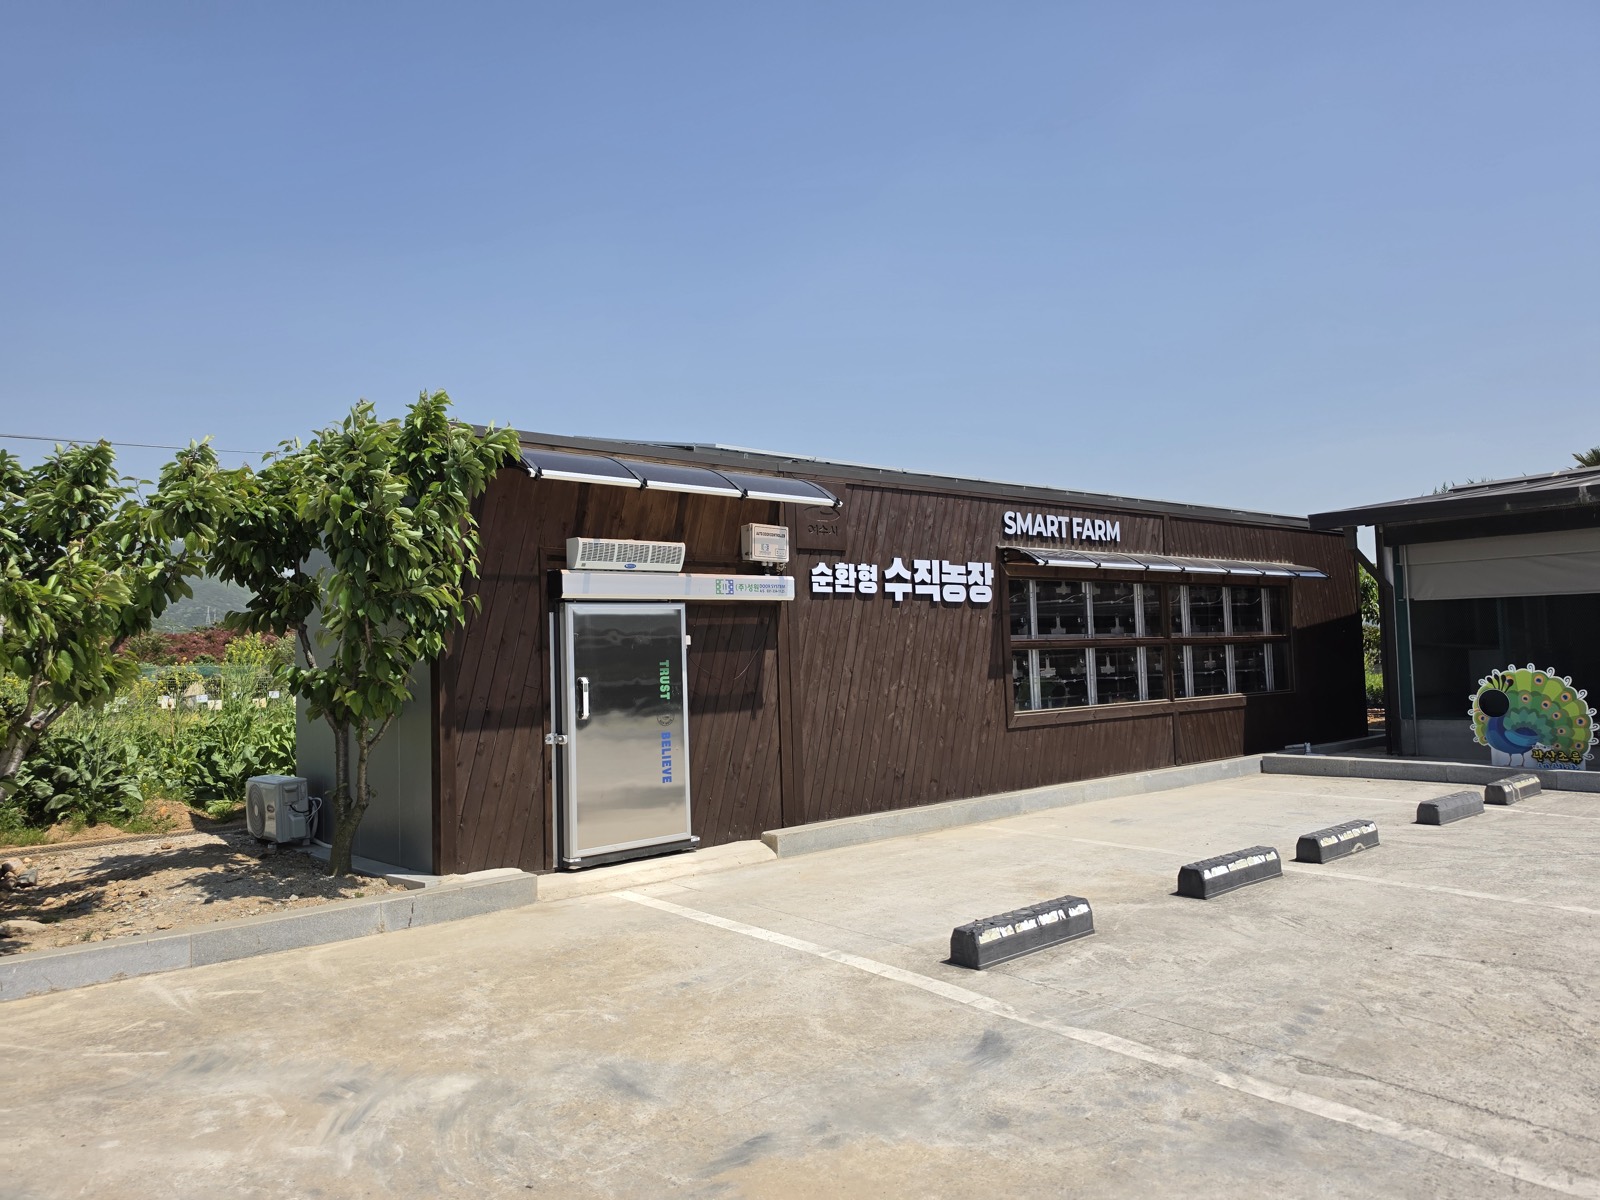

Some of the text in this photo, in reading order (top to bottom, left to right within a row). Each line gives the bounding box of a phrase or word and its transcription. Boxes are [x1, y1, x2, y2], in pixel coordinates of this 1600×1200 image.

[1003, 511, 1121, 542] SMART FARM
[811, 557, 994, 604] 순환형 수직농장
[659, 660, 671, 700] TRUST
[661, 732, 672, 784] BELIEVE
